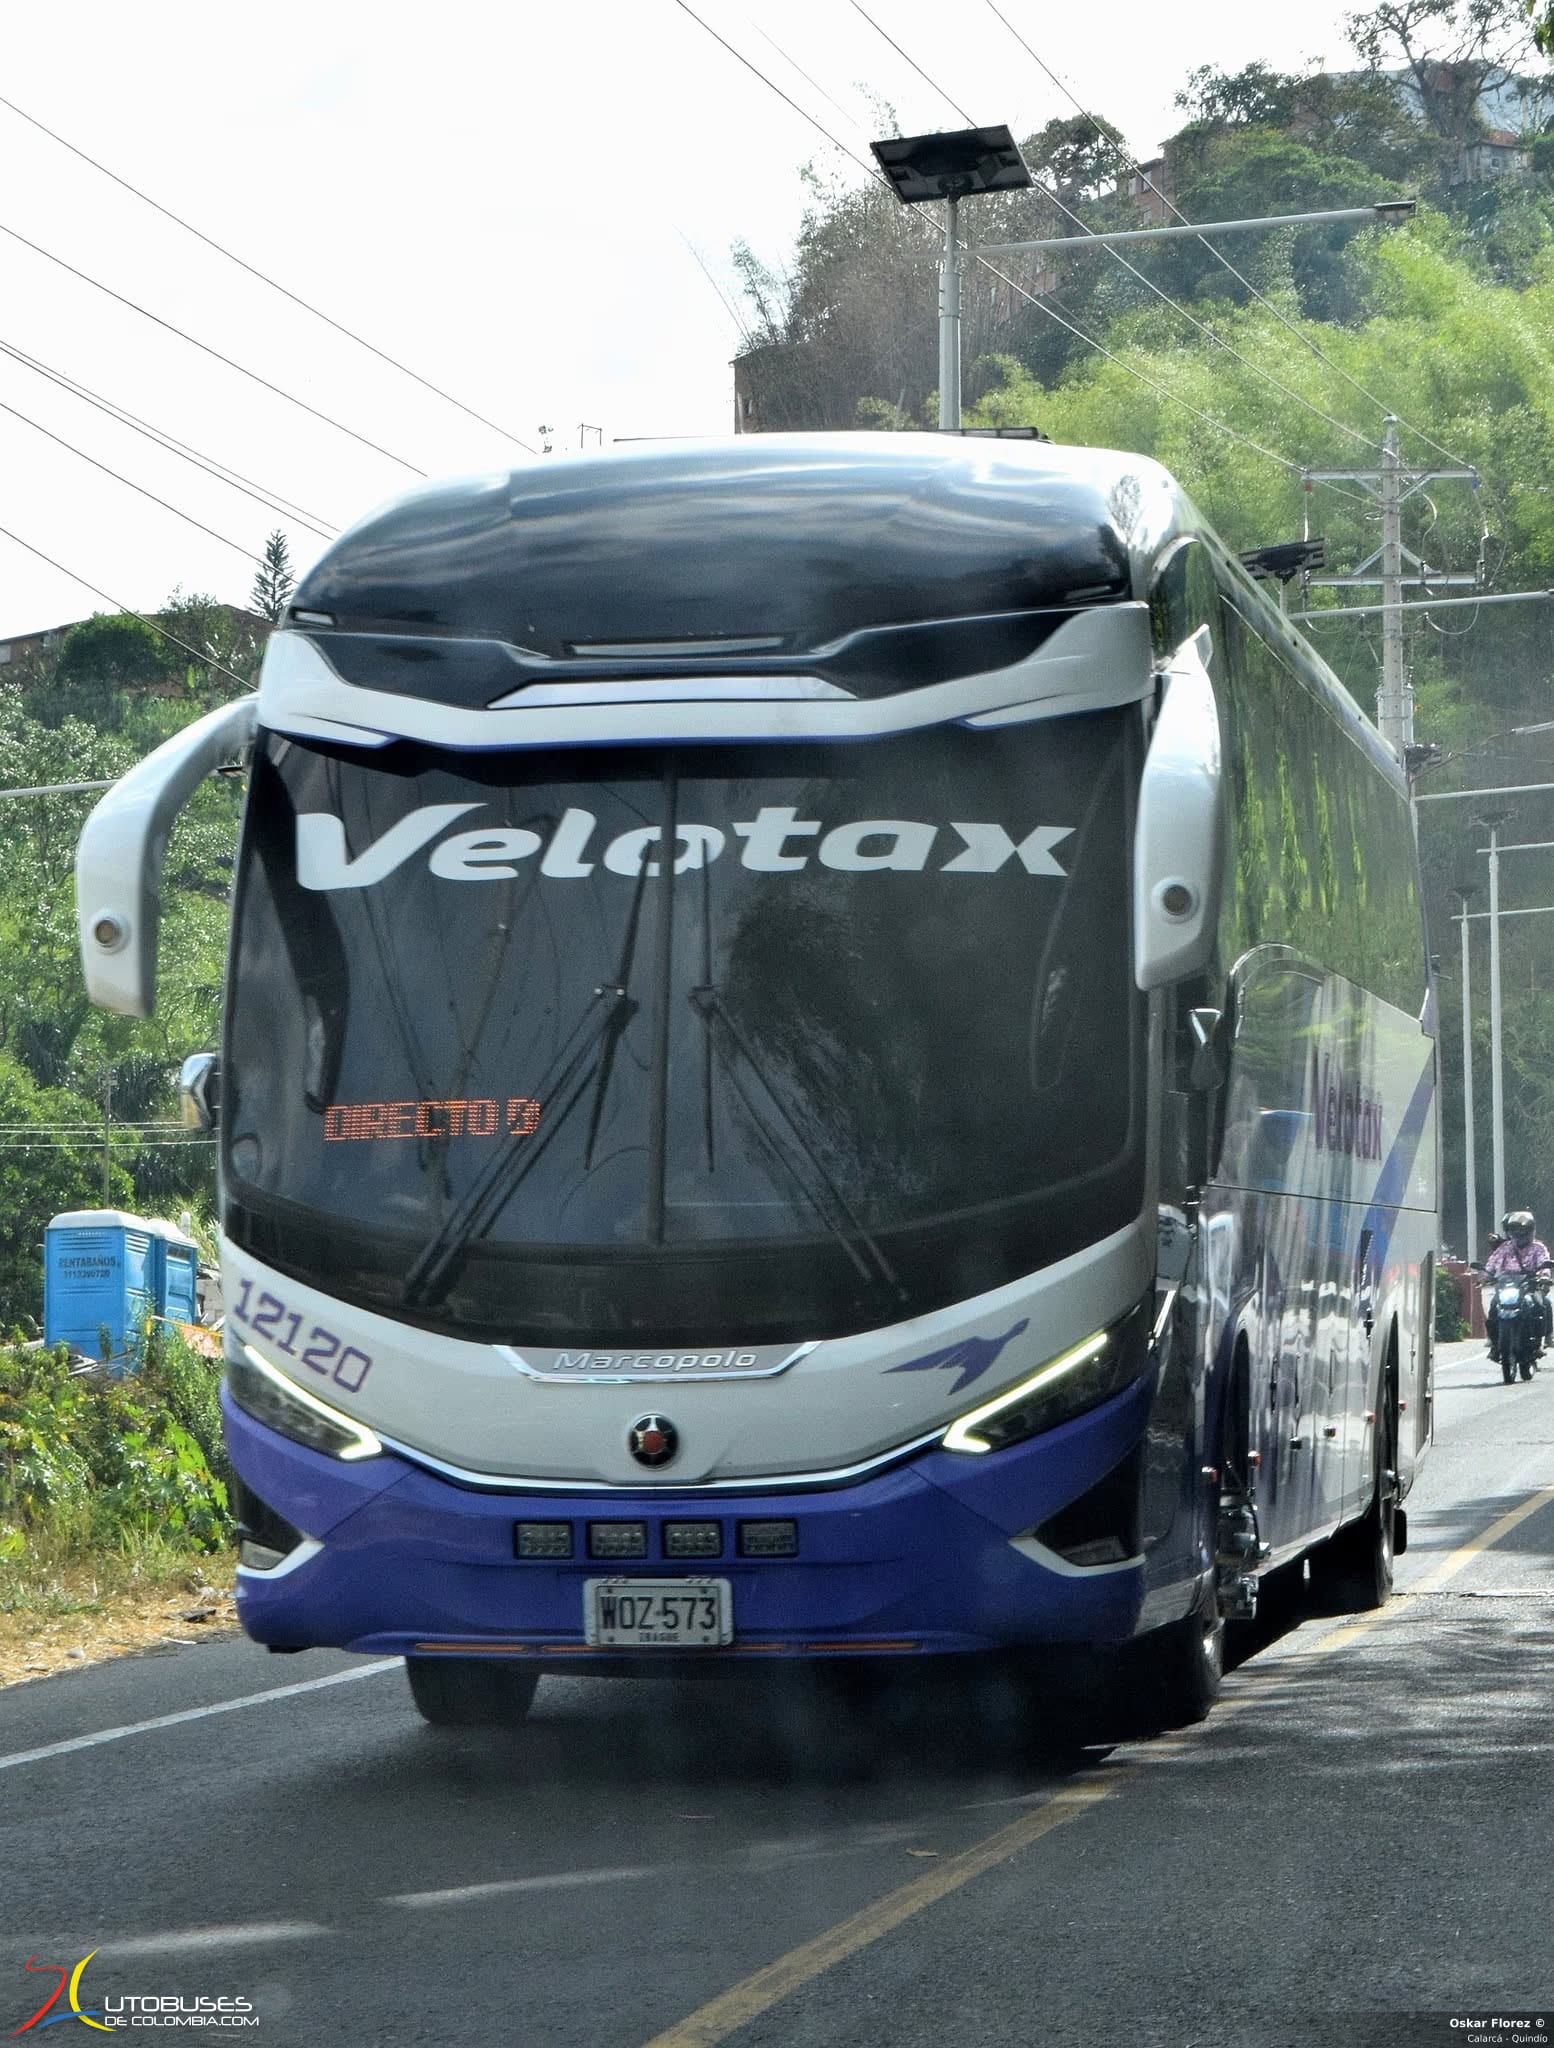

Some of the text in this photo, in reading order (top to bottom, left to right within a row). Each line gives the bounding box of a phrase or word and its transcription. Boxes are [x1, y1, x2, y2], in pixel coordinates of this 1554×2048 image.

[296, 803, 1077, 890] Velotax
[323, 1099, 500, 1142] DIRECTO
[234, 1278, 373, 1393] 12120
[553, 1350, 758, 1372] Marcopolo
